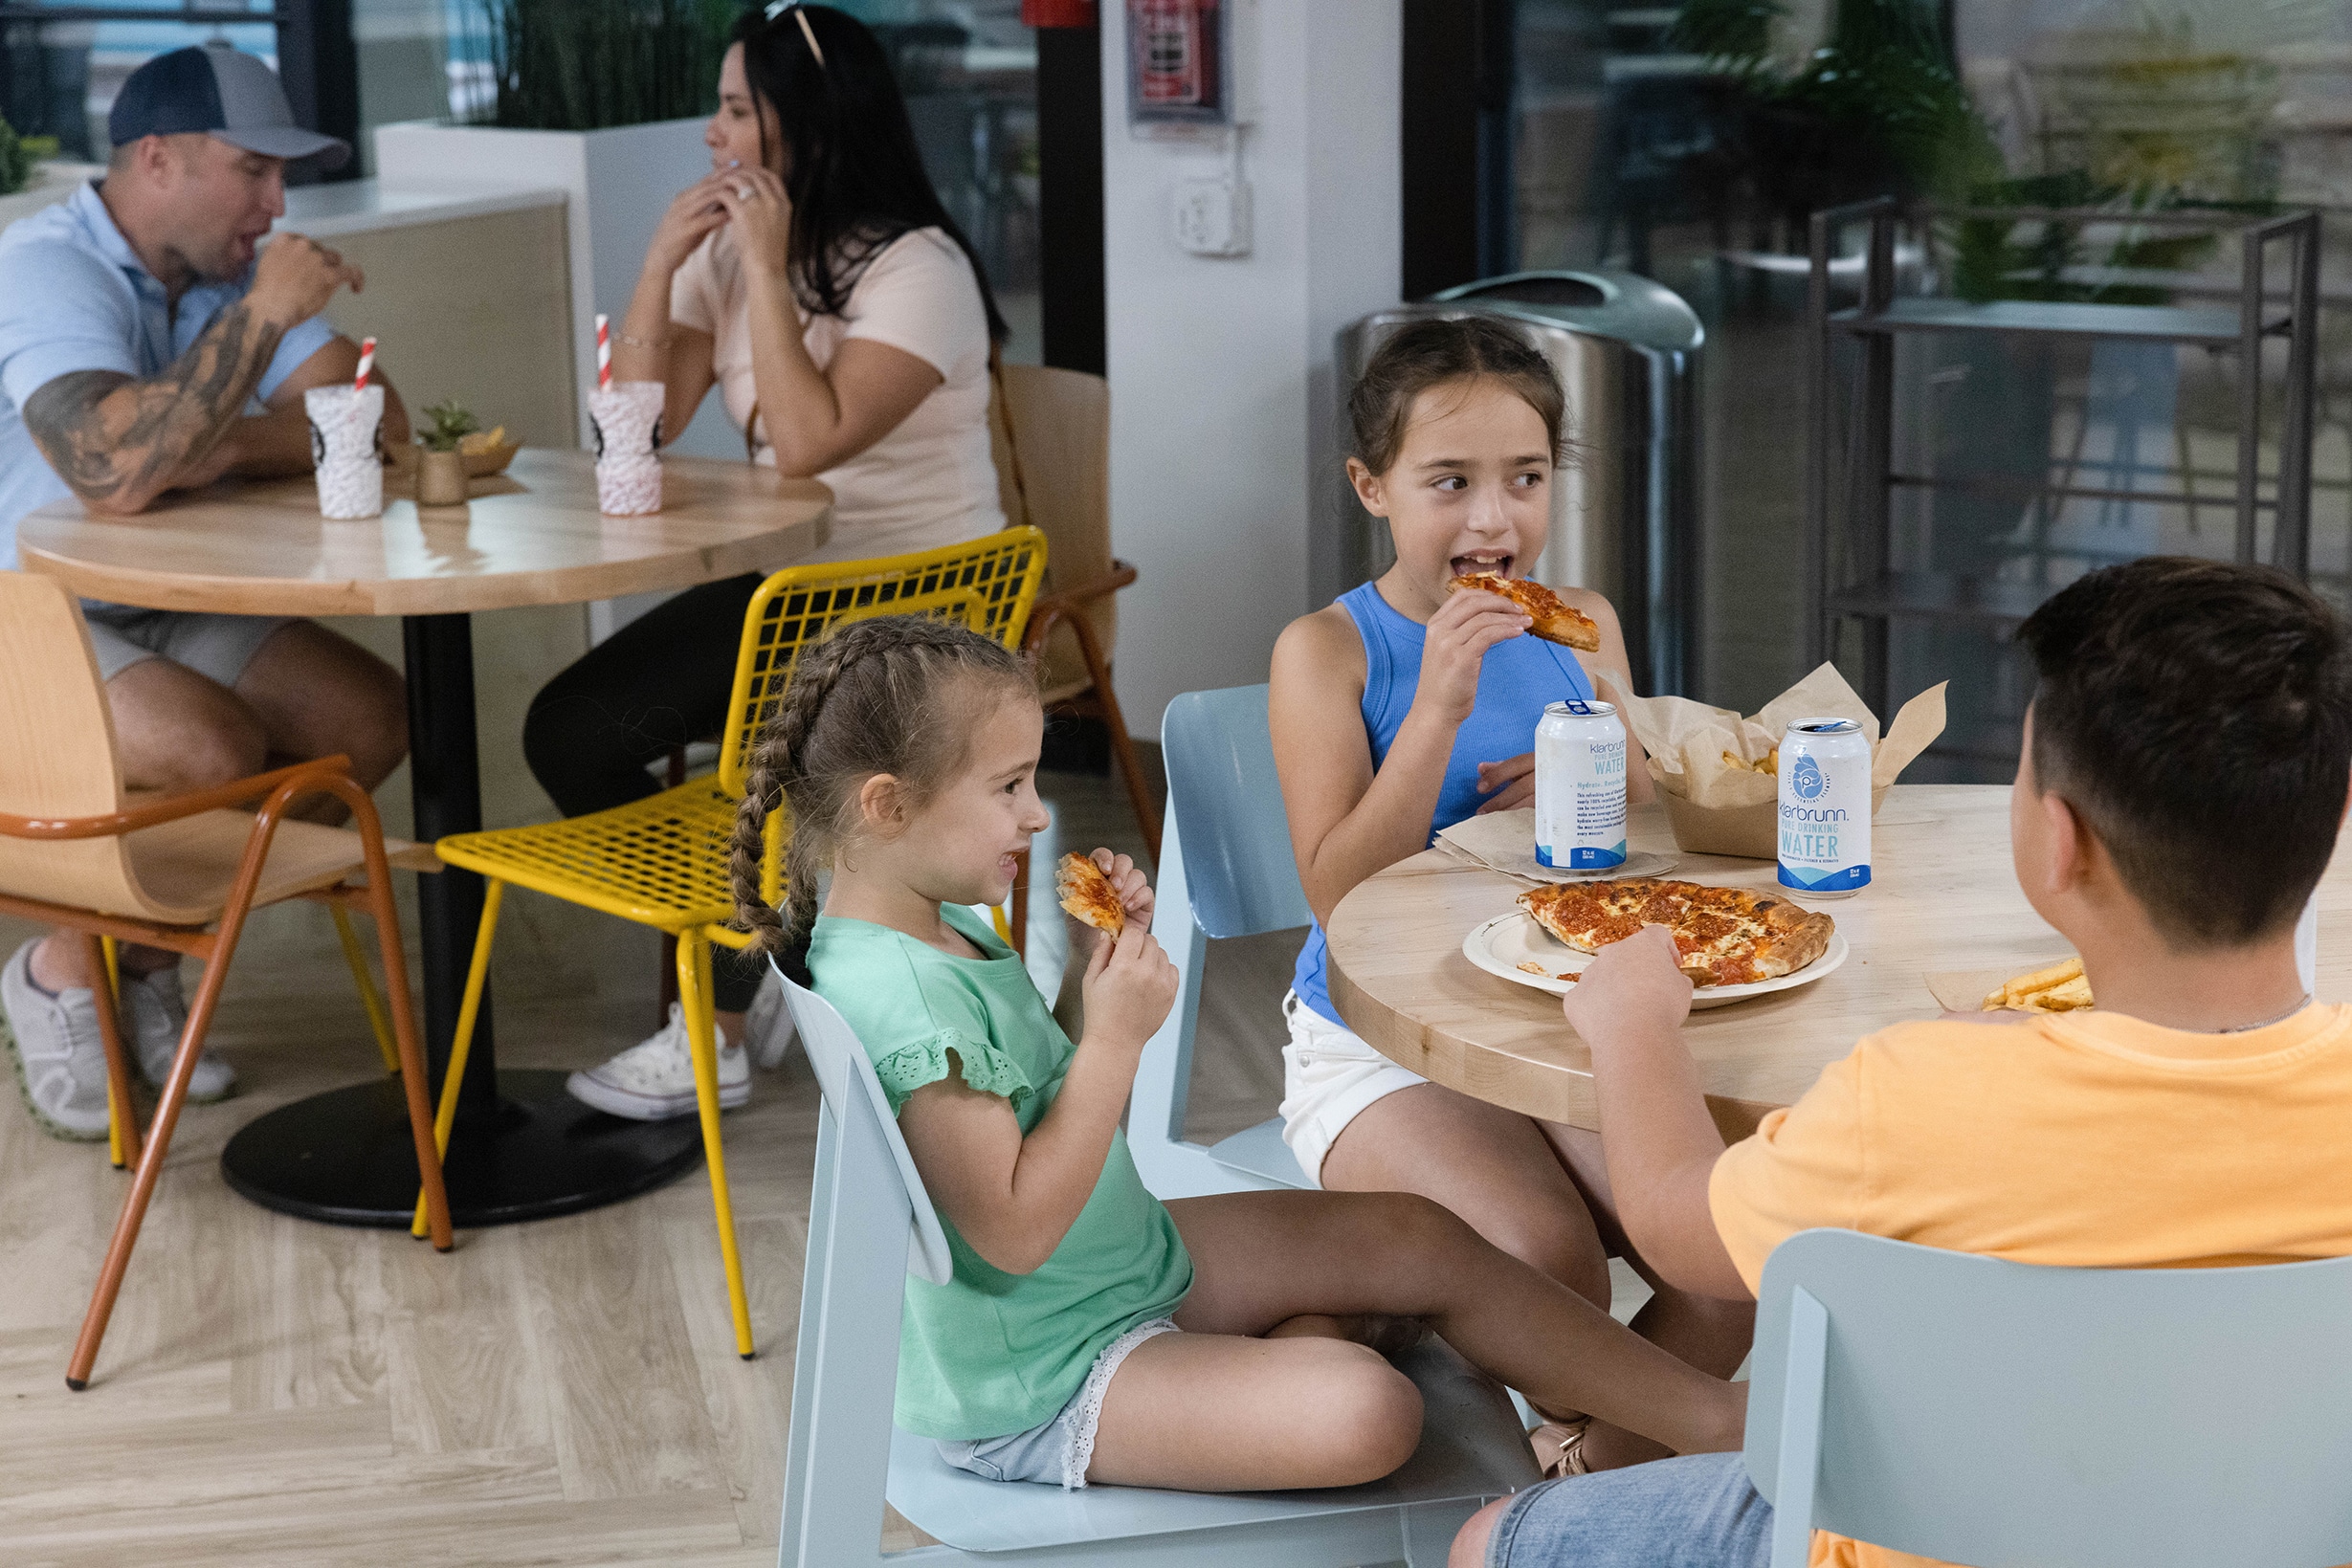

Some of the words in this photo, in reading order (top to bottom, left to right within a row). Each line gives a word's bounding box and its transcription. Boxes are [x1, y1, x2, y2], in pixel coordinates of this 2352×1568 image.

[1594, 757, 1624, 775] WATER
[1792, 792, 1820, 804] ESSENTIAL
[1782, 818, 1795, 830] PURE
[1798, 822, 1839, 833] DRINKING
[1782, 829, 1838, 858] WATER
